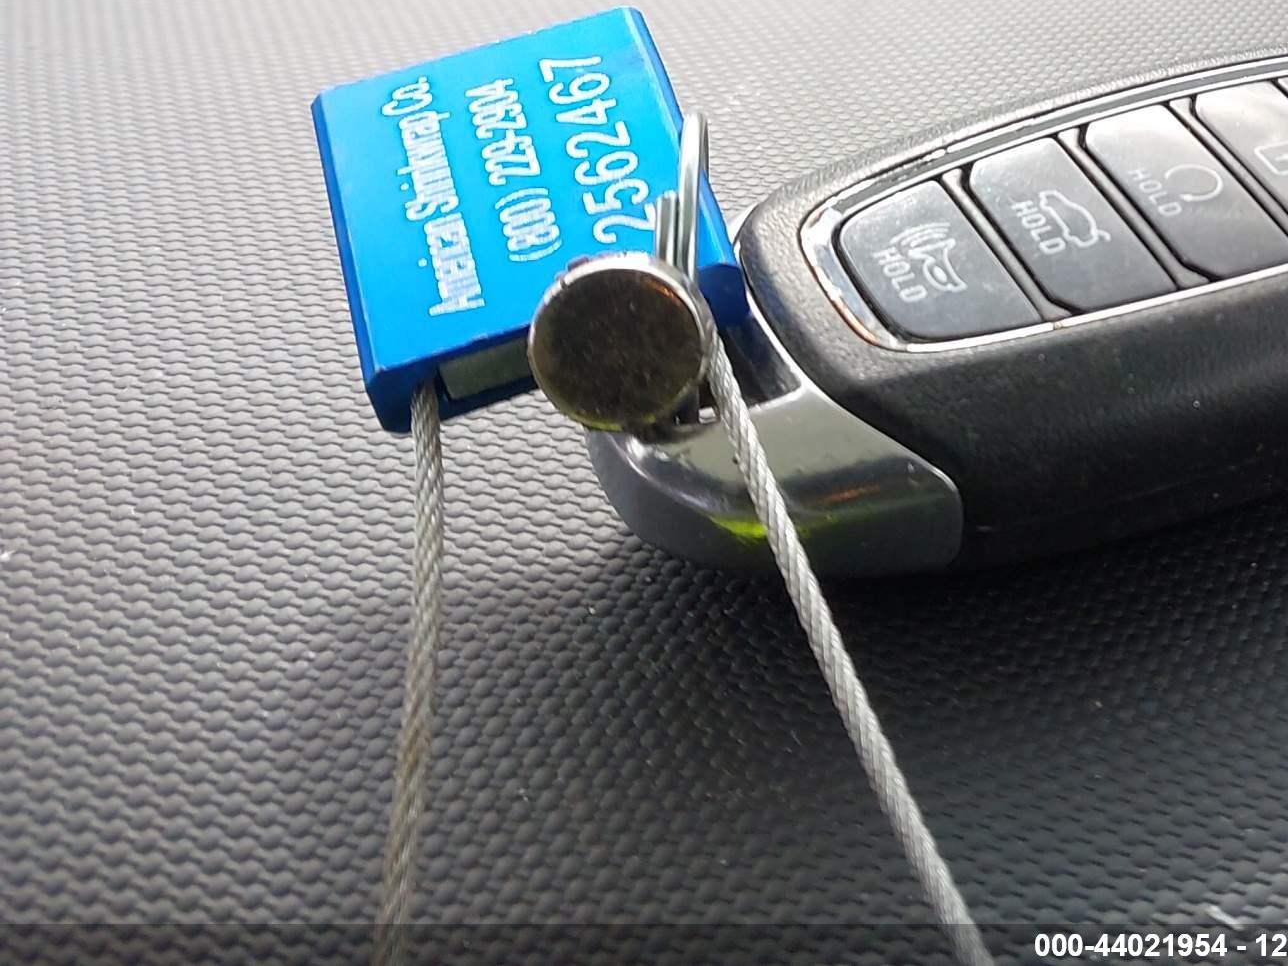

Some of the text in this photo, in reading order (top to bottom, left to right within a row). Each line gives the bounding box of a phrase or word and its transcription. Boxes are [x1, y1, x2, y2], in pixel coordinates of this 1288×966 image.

[381, 75, 486, 316] American Shrinkwrap Co.
[465, 78, 562, 262] (800) 229-2904
[539, 55, 656, 244] 2562467
[1130, 168, 1180, 216] HOLD
[876, 250, 927, 303] HOLD
[1013, 201, 1066, 255] HOLD
